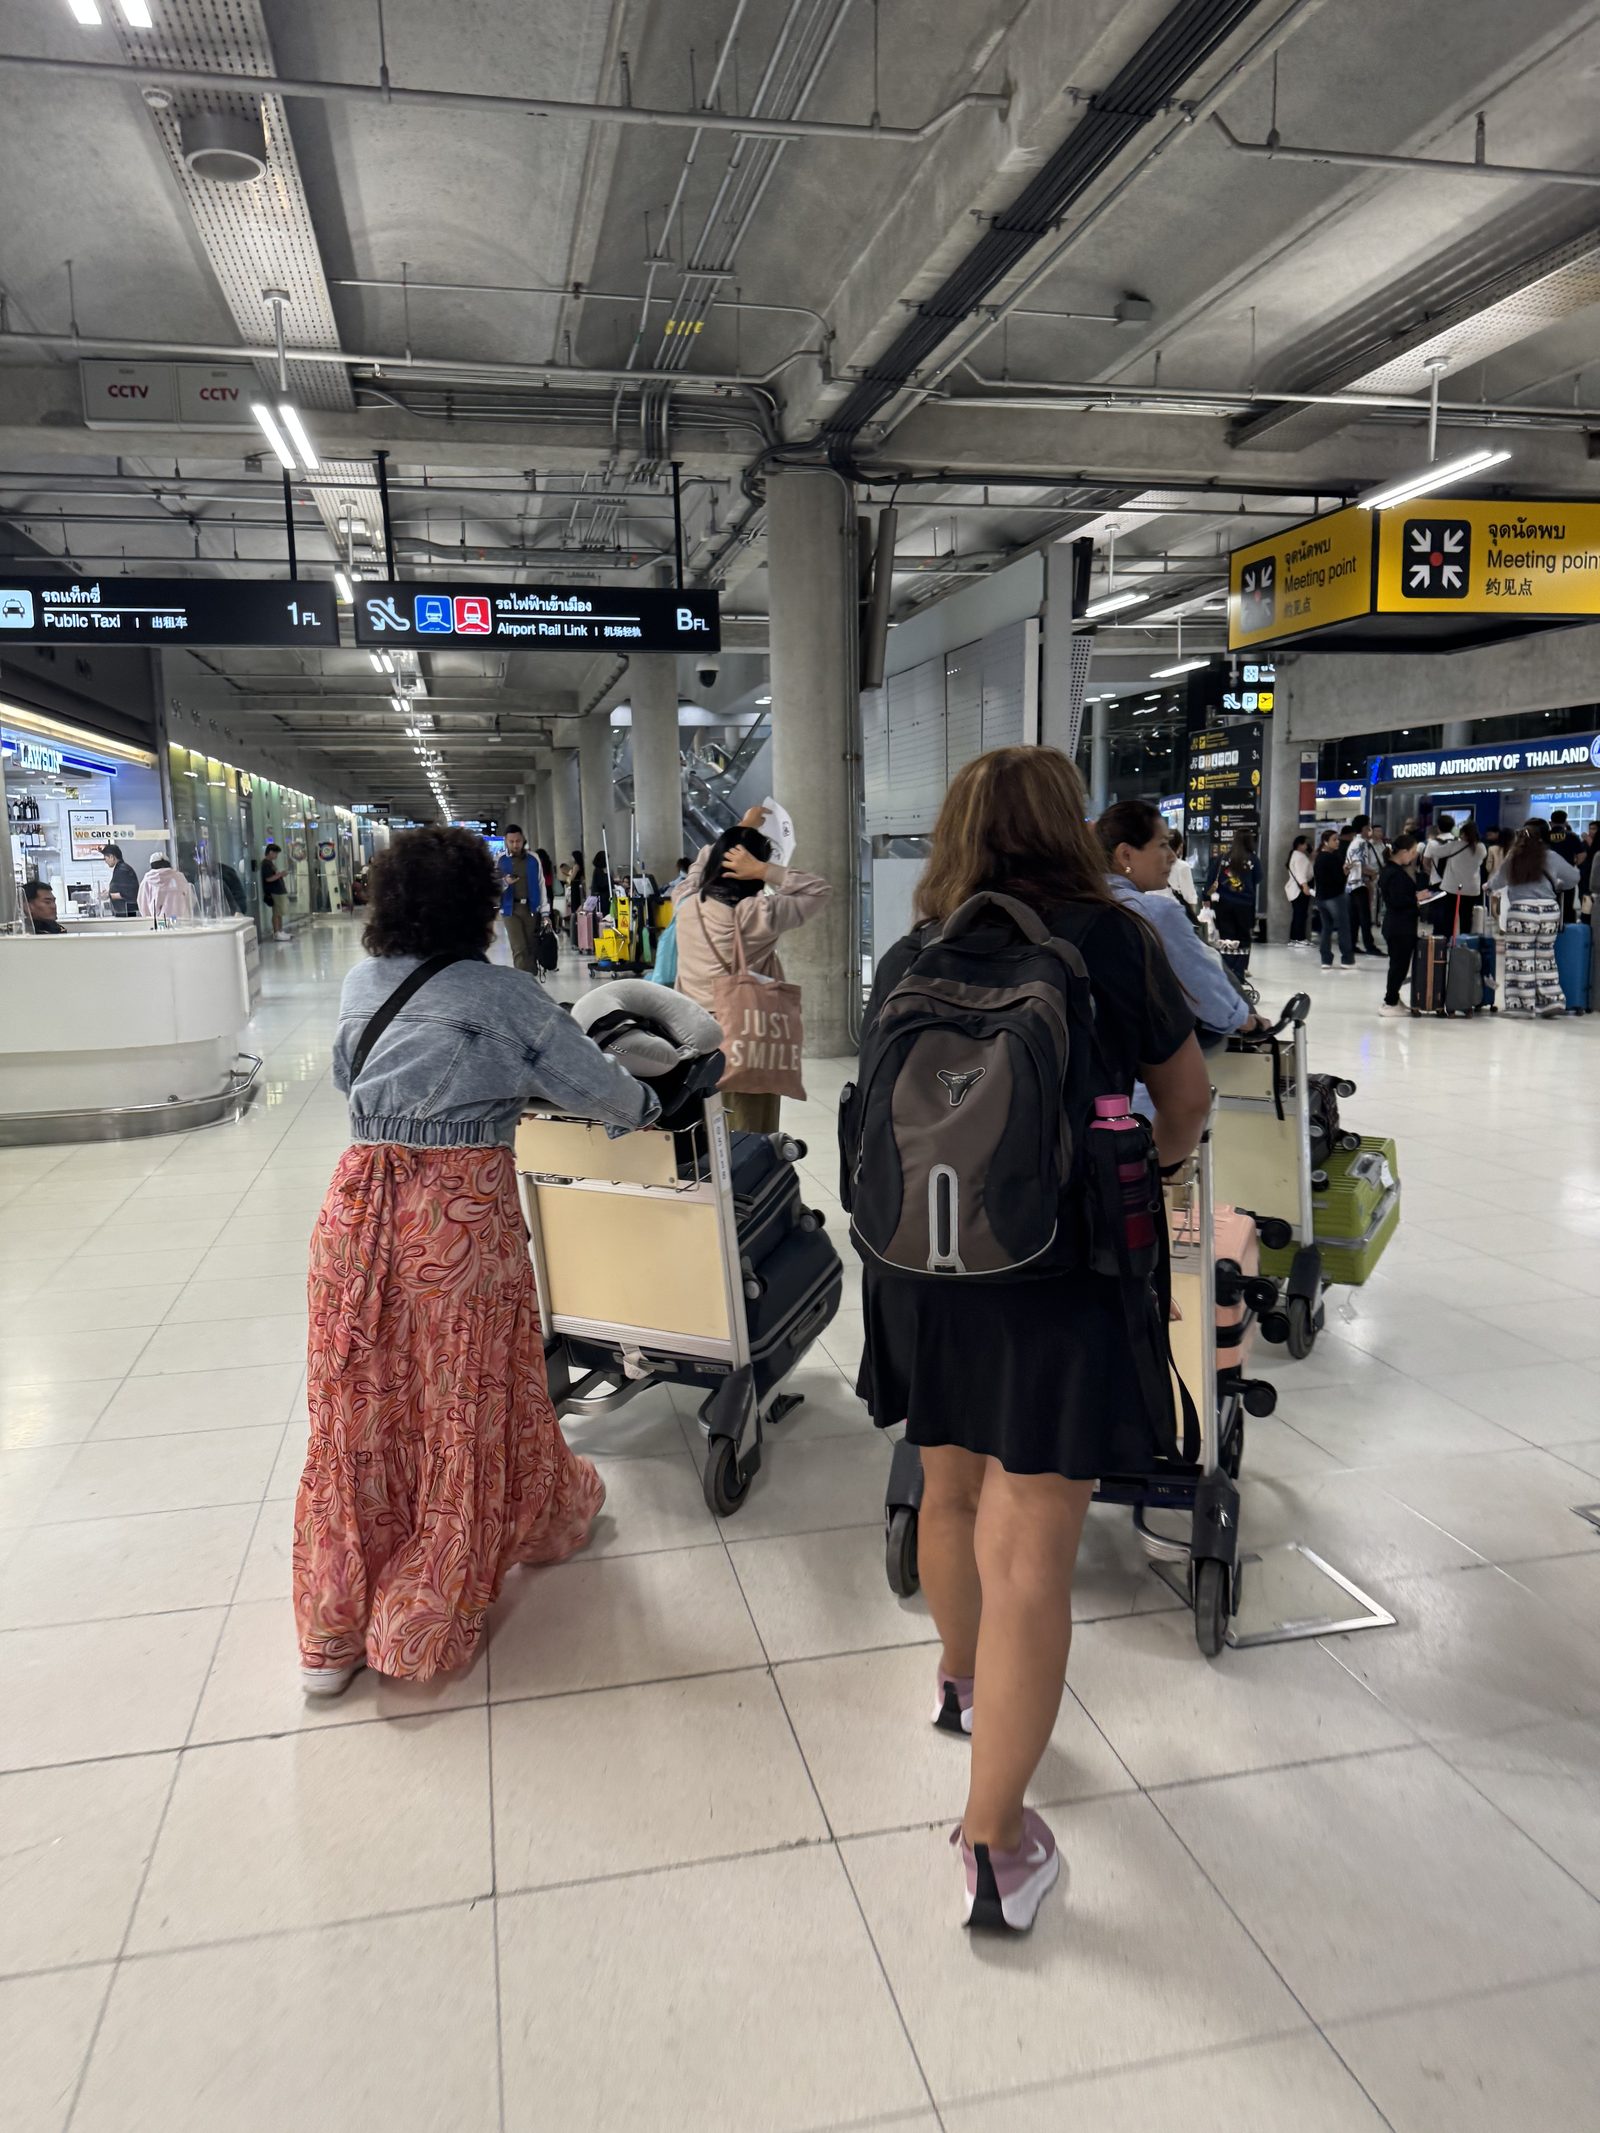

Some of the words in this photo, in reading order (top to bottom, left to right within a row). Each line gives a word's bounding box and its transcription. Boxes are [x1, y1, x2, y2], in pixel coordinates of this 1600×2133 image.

[108, 385, 148, 398] CCTV
[199, 388, 239, 400] CCTV
[1488, 516, 1566, 546] จุดนัดพบ
[1285, 537, 1331, 572] จุดนัดพบ
[1487, 550, 1556, 573] Meeting
[1562, 551, 1600, 573] poin
[1284, 569, 1326, 594] Meeting
[1328, 556, 1357, 584] point
[42, 583, 100, 603] รถแท็กซี่
[1485, 578, 1532, 596] 约见点
[495, 592, 592, 612] รถไฟฟ้าเข้าเมือง
[44, 613, 89, 628] Public
[91, 613, 121, 628] Taxi
[152, 615, 188, 629] 出租车
[497, 622, 536, 637] Airport
[538, 623, 561, 636] Rail
[563, 624, 588, 637] Link
[20, 743, 63, 774] LAWSON
[1392, 762, 1436, 778] TOURISM
[1439, 756, 1502, 775] AUTHORITY
[1503, 754, 1520, 769] OF
[1525, 746, 1589, 767] THAILAND
[1349, 784, 1364, 792] AOT
[75, 831, 90, 839] we
[91, 830, 112, 839] care
[741, 1009, 791, 1039] JUST
[730, 1040, 800, 1071] SMILE
